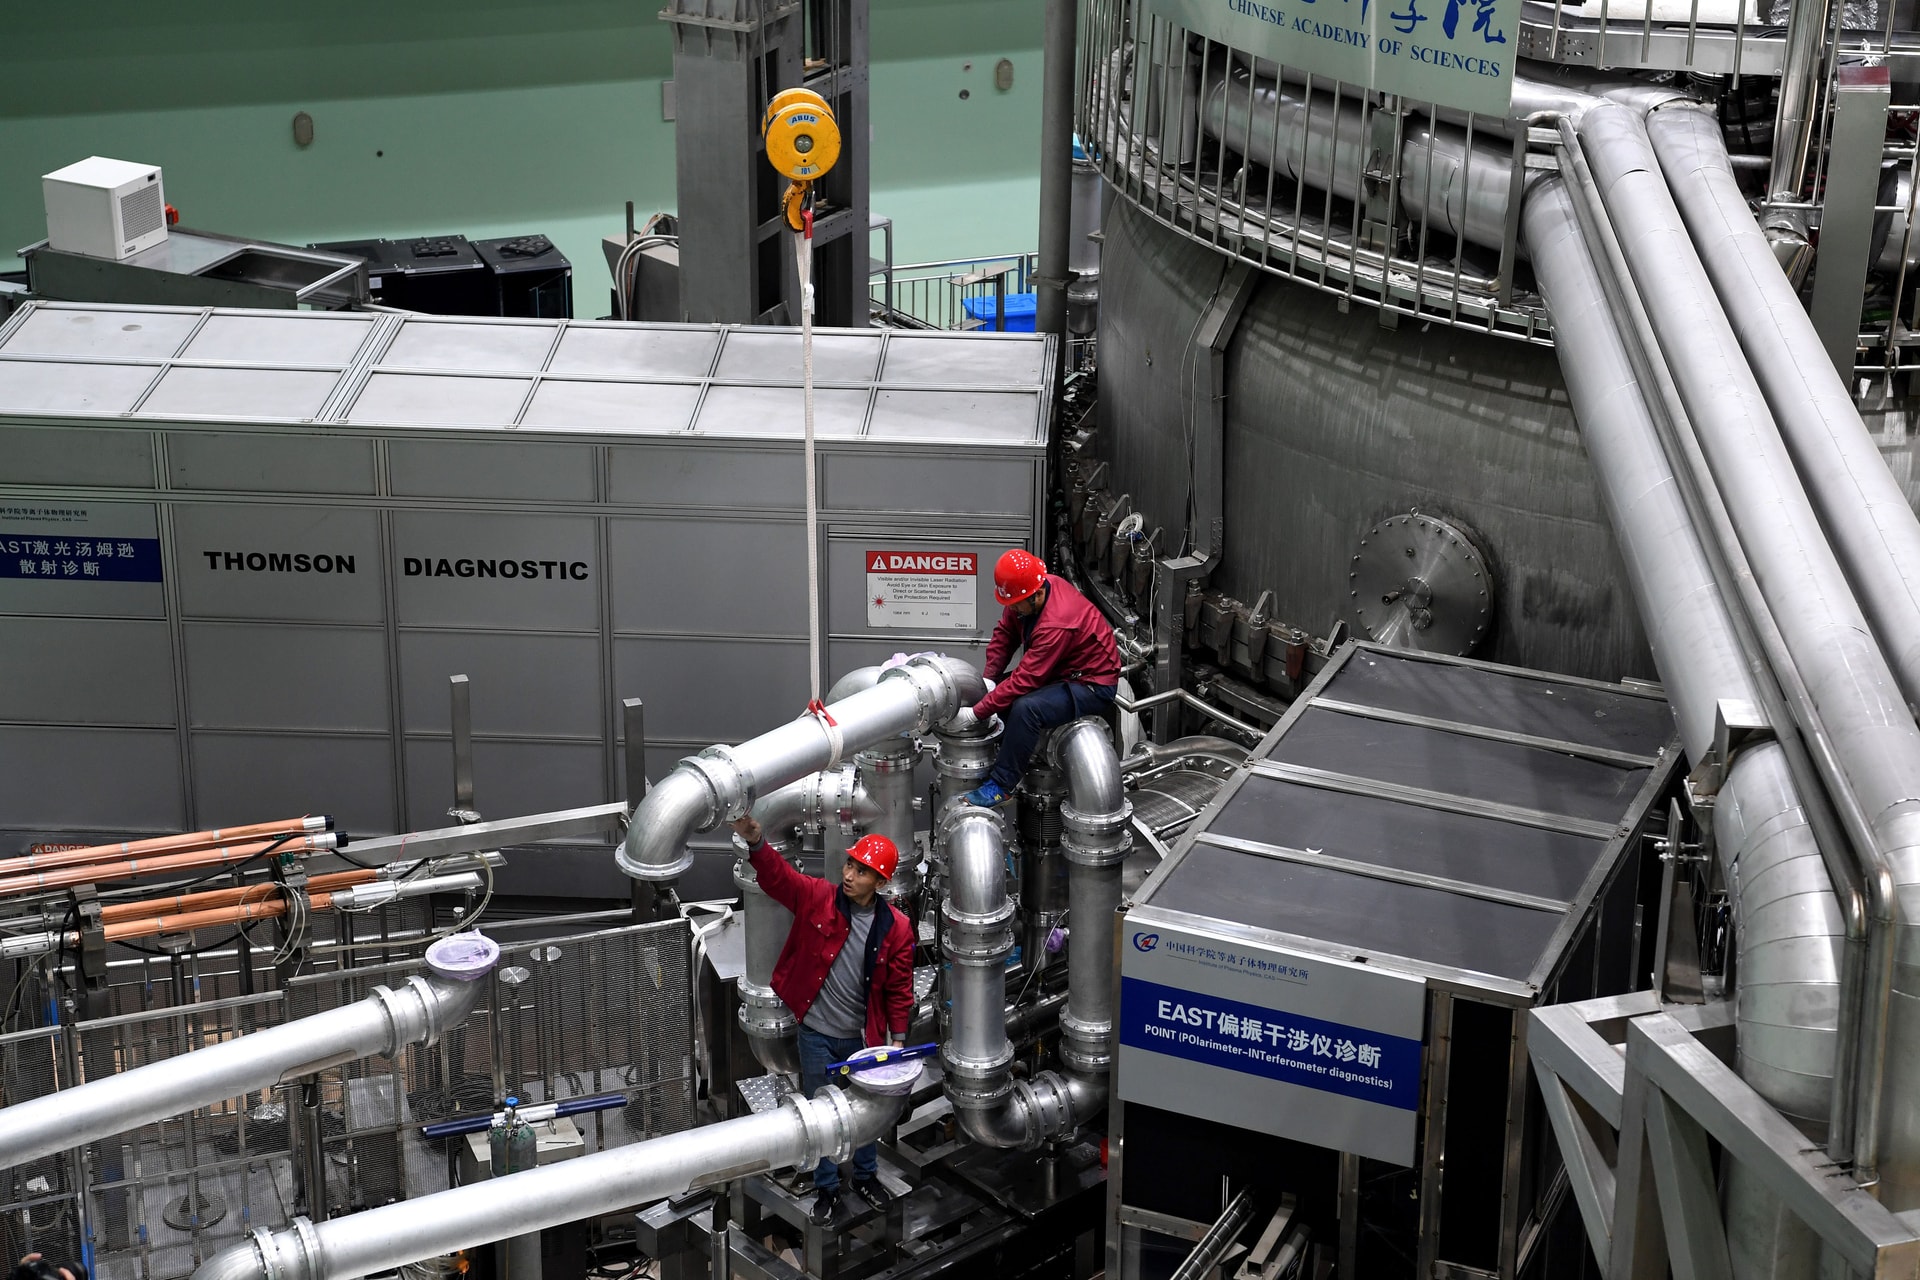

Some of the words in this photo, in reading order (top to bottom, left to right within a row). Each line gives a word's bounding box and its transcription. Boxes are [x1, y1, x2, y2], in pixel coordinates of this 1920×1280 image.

[1229, 0, 1285, 26] CHINESE
[1291, 17, 1370, 49] ACADEMY
[1379, 38, 1402, 56] OF
[1410, 46, 1500, 78] SCIENCES
[791, 115, 815, 124] ABUS
[19, 559, 100, 576] 散射诊断
[203, 551, 355, 573] THOMSON
[404, 558, 589, 580] DIAGNOSTIC
[890, 556, 973, 570] DANGER
[1166, 940, 1309, 980] 中国科学院等离子体物理研究所
[1158, 1000, 1382, 1069] EAST偏振干涉仪诊断
[1144, 1024, 1176, 1040] POINT
[1329, 1067, 1393, 1090] diagnostics)
